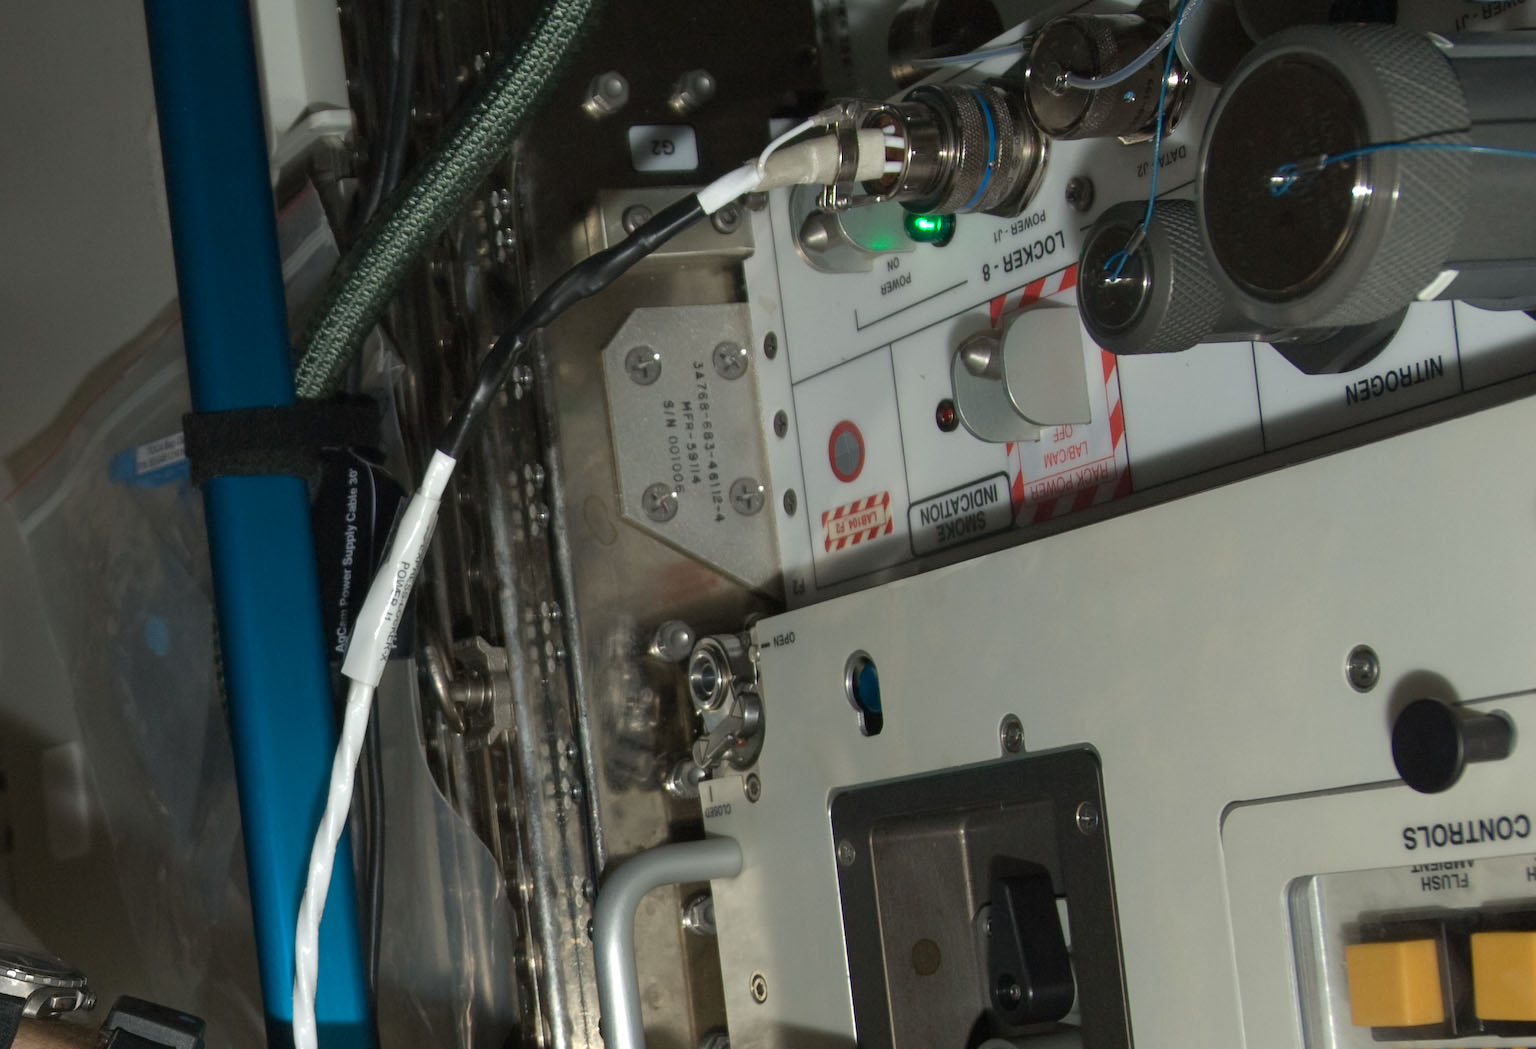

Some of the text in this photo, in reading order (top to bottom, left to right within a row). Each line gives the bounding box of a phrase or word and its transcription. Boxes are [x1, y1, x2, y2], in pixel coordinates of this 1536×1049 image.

[651, 140, 674, 155] G2
[991, 227, 1004, 242] J1
[1009, 209, 1047, 235] POWER
[886, 256, 900, 271] ON
[1001, 230, 1065, 273] LOCKER
[879, 271, 912, 295] POWER
[980, 263, 991, 282] 8
[1344, 355, 1444, 405] NITROGEN
[663, 399, 675, 428] S/N
[1042, 440, 1089, 468] LAB/CAM
[1029, 462, 1110, 500] RACK POWER
[344, 487, 357, 521] Cable
[918, 483, 1000, 525] INDICATION
[935, 510, 987, 543] SMOKE
[342, 524, 358, 566] Supply
[338, 567, 351, 605] Power
[772, 631, 795, 647] OPEN
[1401, 814, 1531, 849] CONTROLS
[1420, 871, 1469, 893] FLUSH
